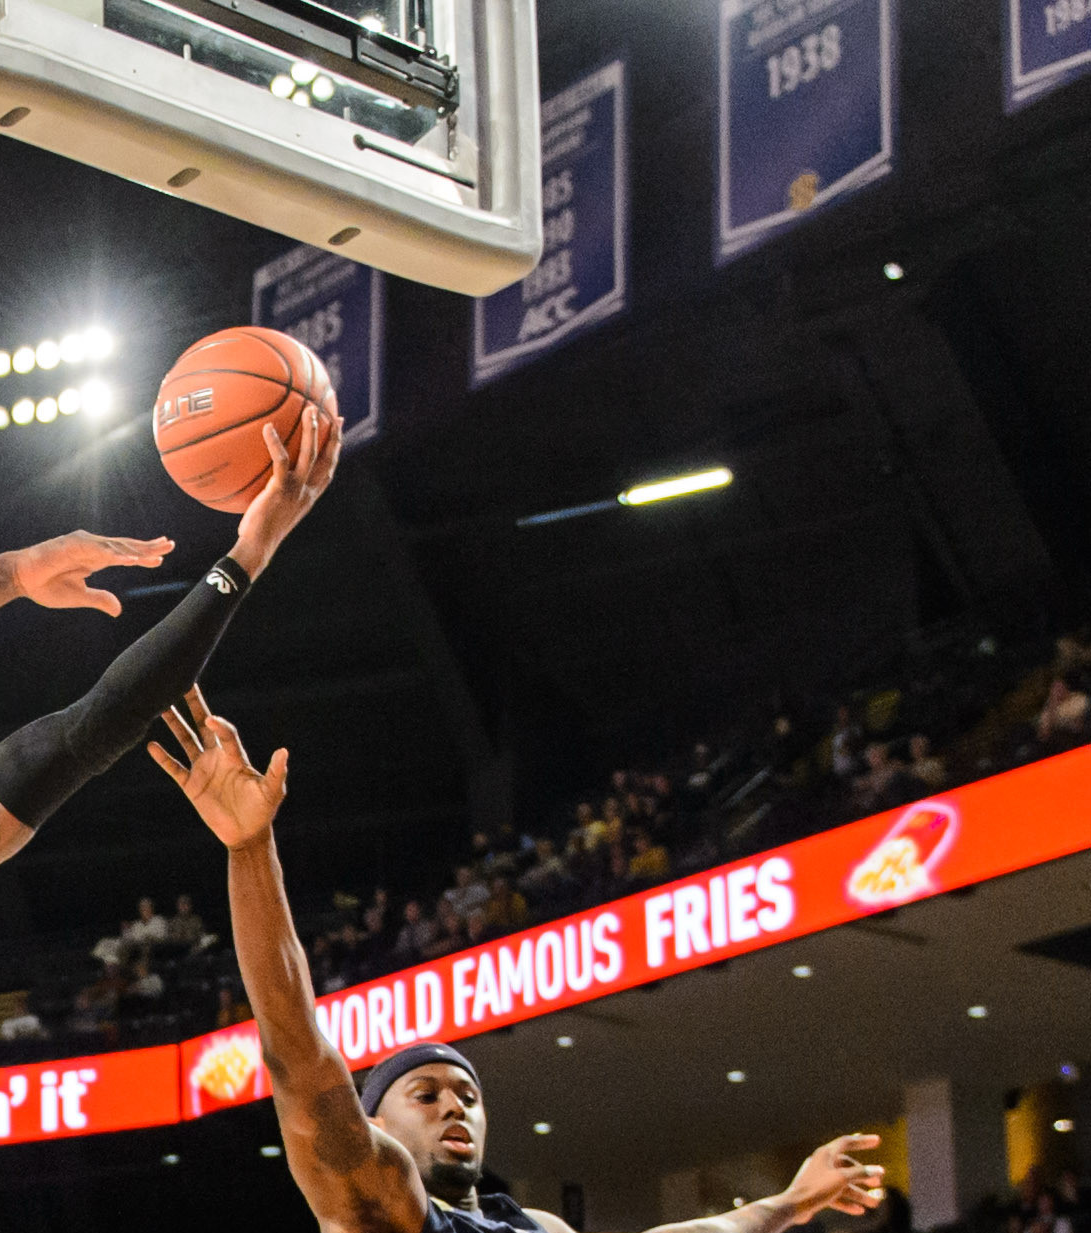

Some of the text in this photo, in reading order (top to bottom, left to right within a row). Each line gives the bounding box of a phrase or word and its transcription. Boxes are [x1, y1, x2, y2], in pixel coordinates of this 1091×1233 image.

[767, 24, 842, 98] 1938
[517, 286, 579, 342] ACC
[452, 913, 622, 1028] FAMOUS
[643, 857, 794, 968] FRIES
